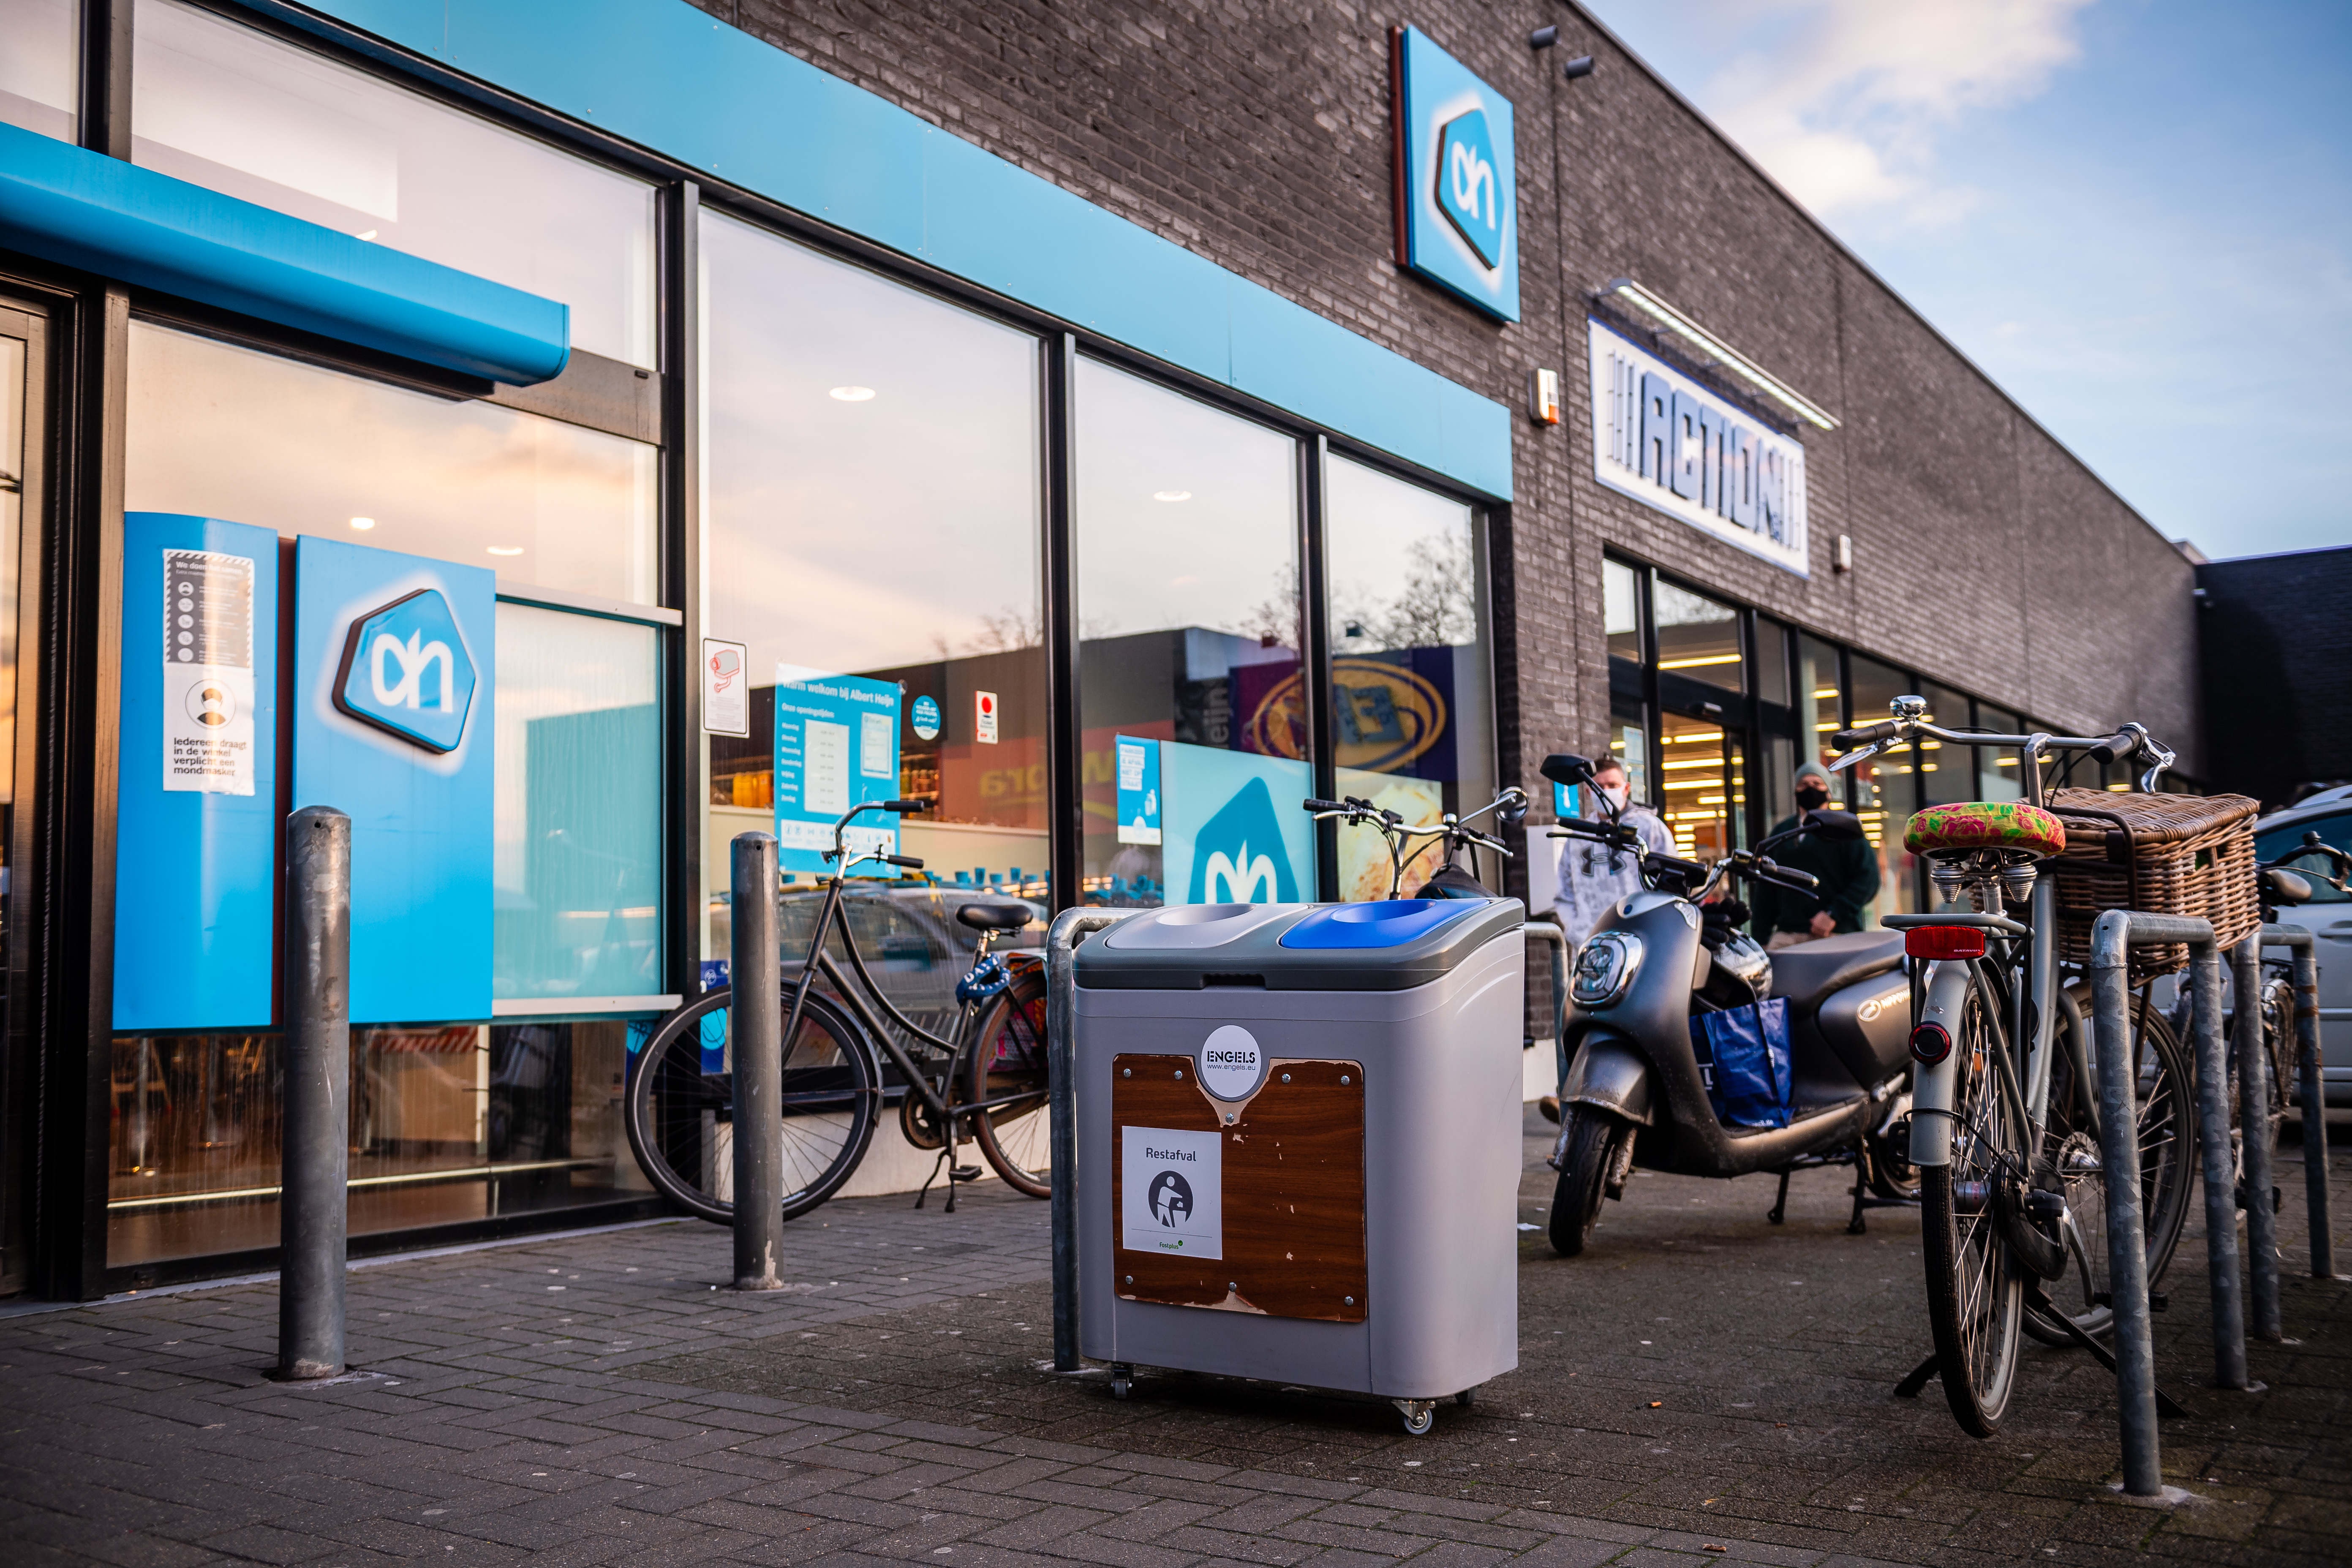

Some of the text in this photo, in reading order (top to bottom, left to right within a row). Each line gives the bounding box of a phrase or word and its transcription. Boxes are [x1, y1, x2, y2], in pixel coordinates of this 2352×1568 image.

[1642, 370, 1781, 541] ACTION
[176, 561, 188, 569] We
[189, 562, 207, 570] doen
[782, 678, 895, 708] Warm welkom bij Albert Heijn
[781, 702, 796, 712] Onze
[173, 737, 247, 750] Iedereen draagt
[174, 746, 231, 757] in de winkel
[173, 756, 217, 766] verplicht
[173, 766, 236, 776] mondmasker
[1207, 1051, 1255, 1064] ENGELS
[1146, 1147, 1197, 1162] Restafval
[1159, 1241, 1179, 1250] Fostplus
